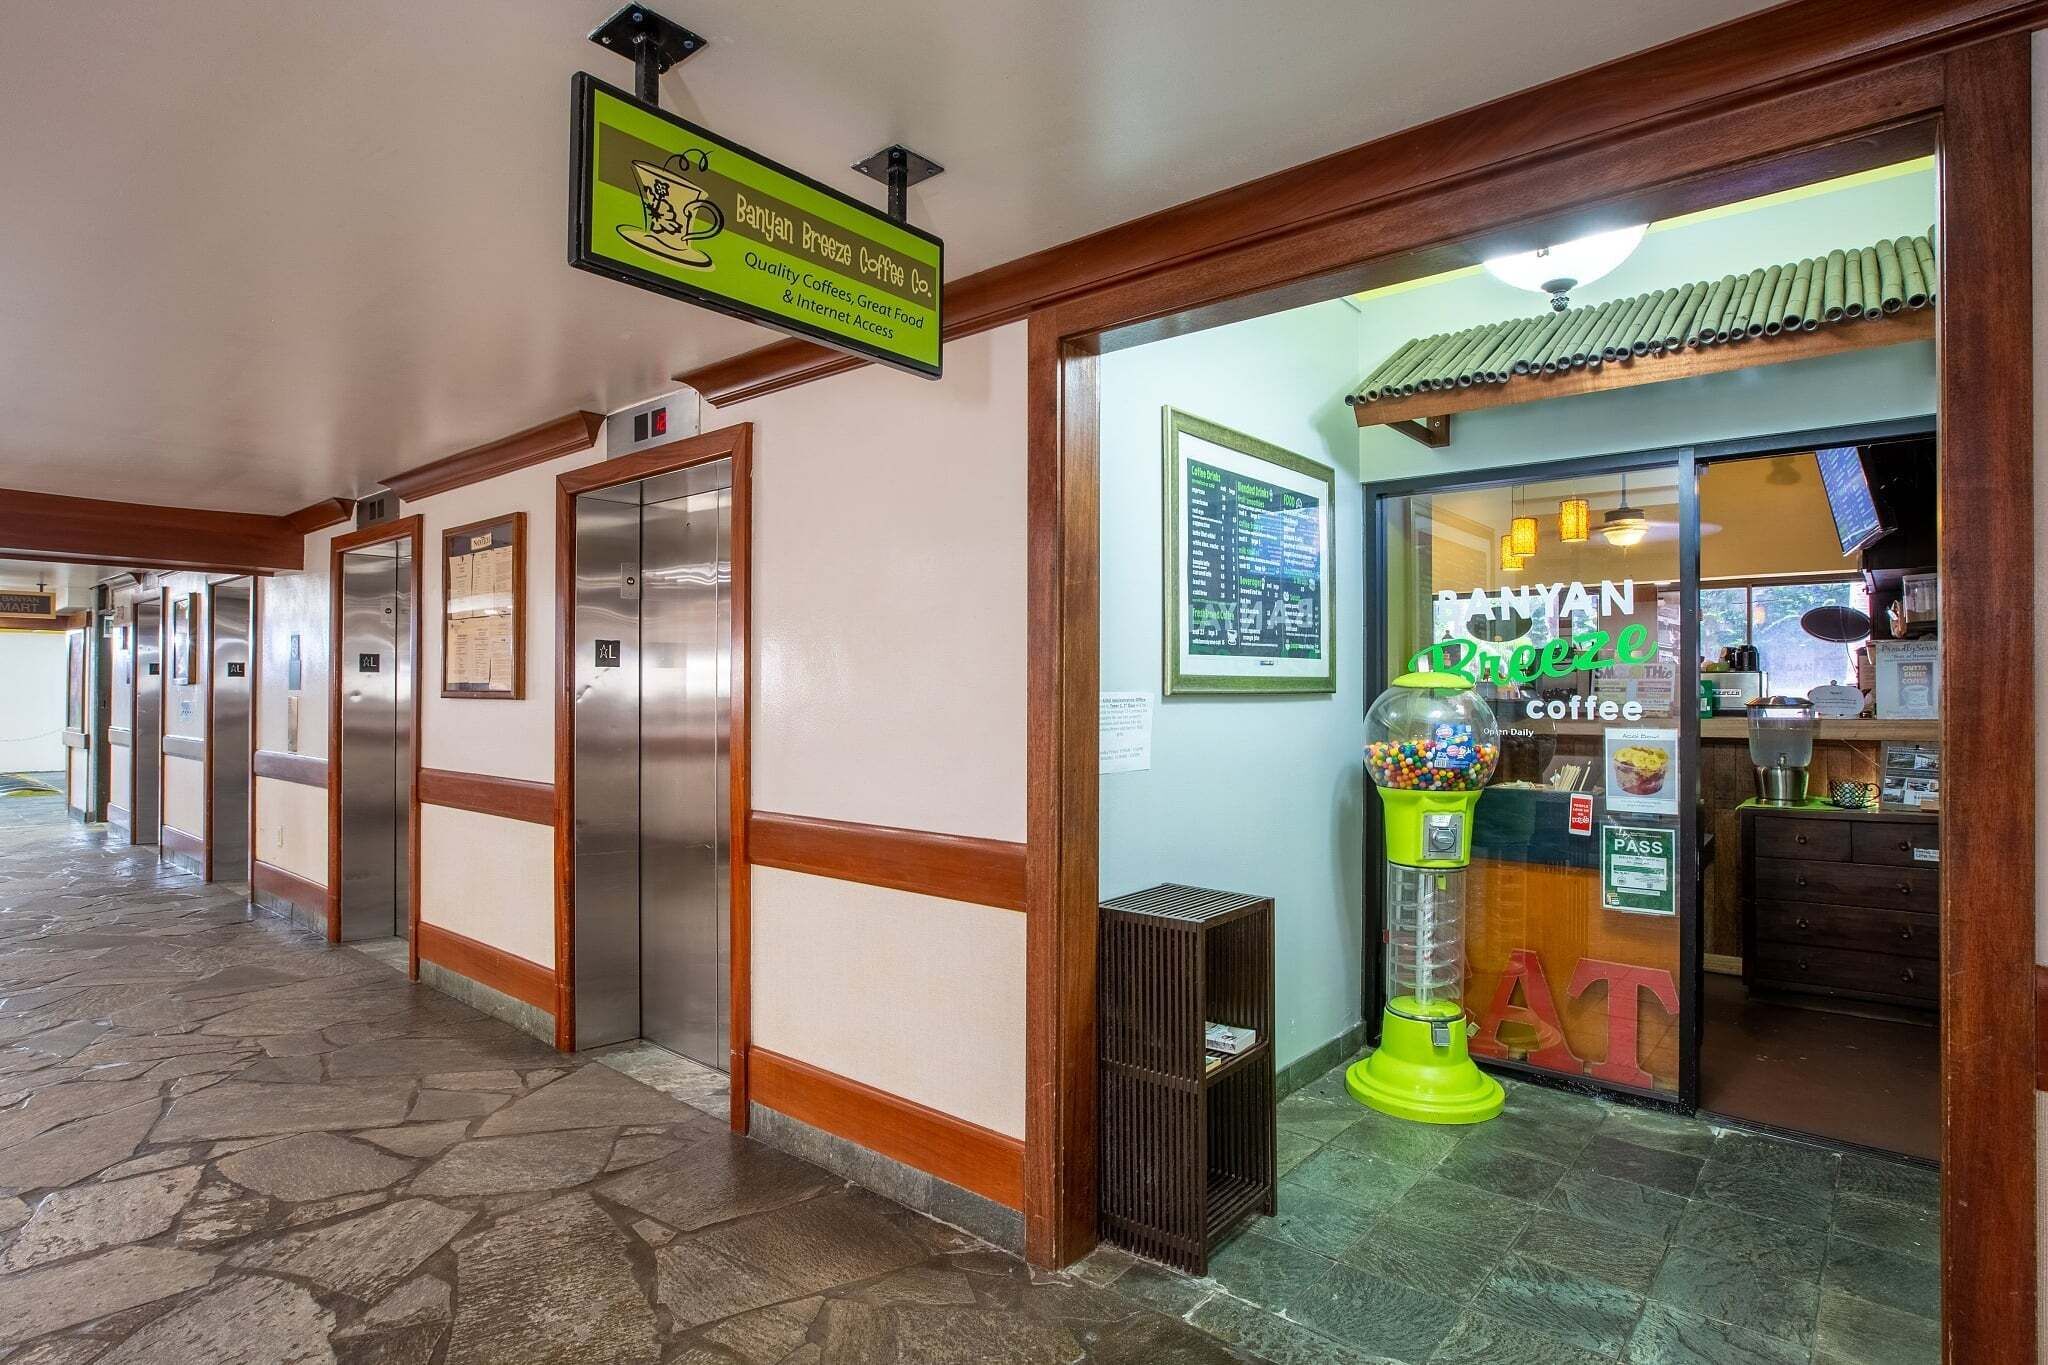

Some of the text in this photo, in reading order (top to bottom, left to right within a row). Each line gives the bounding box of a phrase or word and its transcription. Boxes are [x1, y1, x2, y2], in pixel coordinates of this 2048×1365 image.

[736, 192, 932, 298] Banyan Breeze Coffee Co.
[744, 252, 924, 329] Quality Coffees, Great Food
[782, 288, 894, 339] & Internet Access
[0, 602, 40, 613] MART
[1408, 623, 1658, 696] Breeze
[1483, 727, 1535, 738] Open Daily
[1526, 695, 1643, 720] coffee
[1614, 838, 1663, 854] PASS
[1464, 949, 1680, 1089] AT
